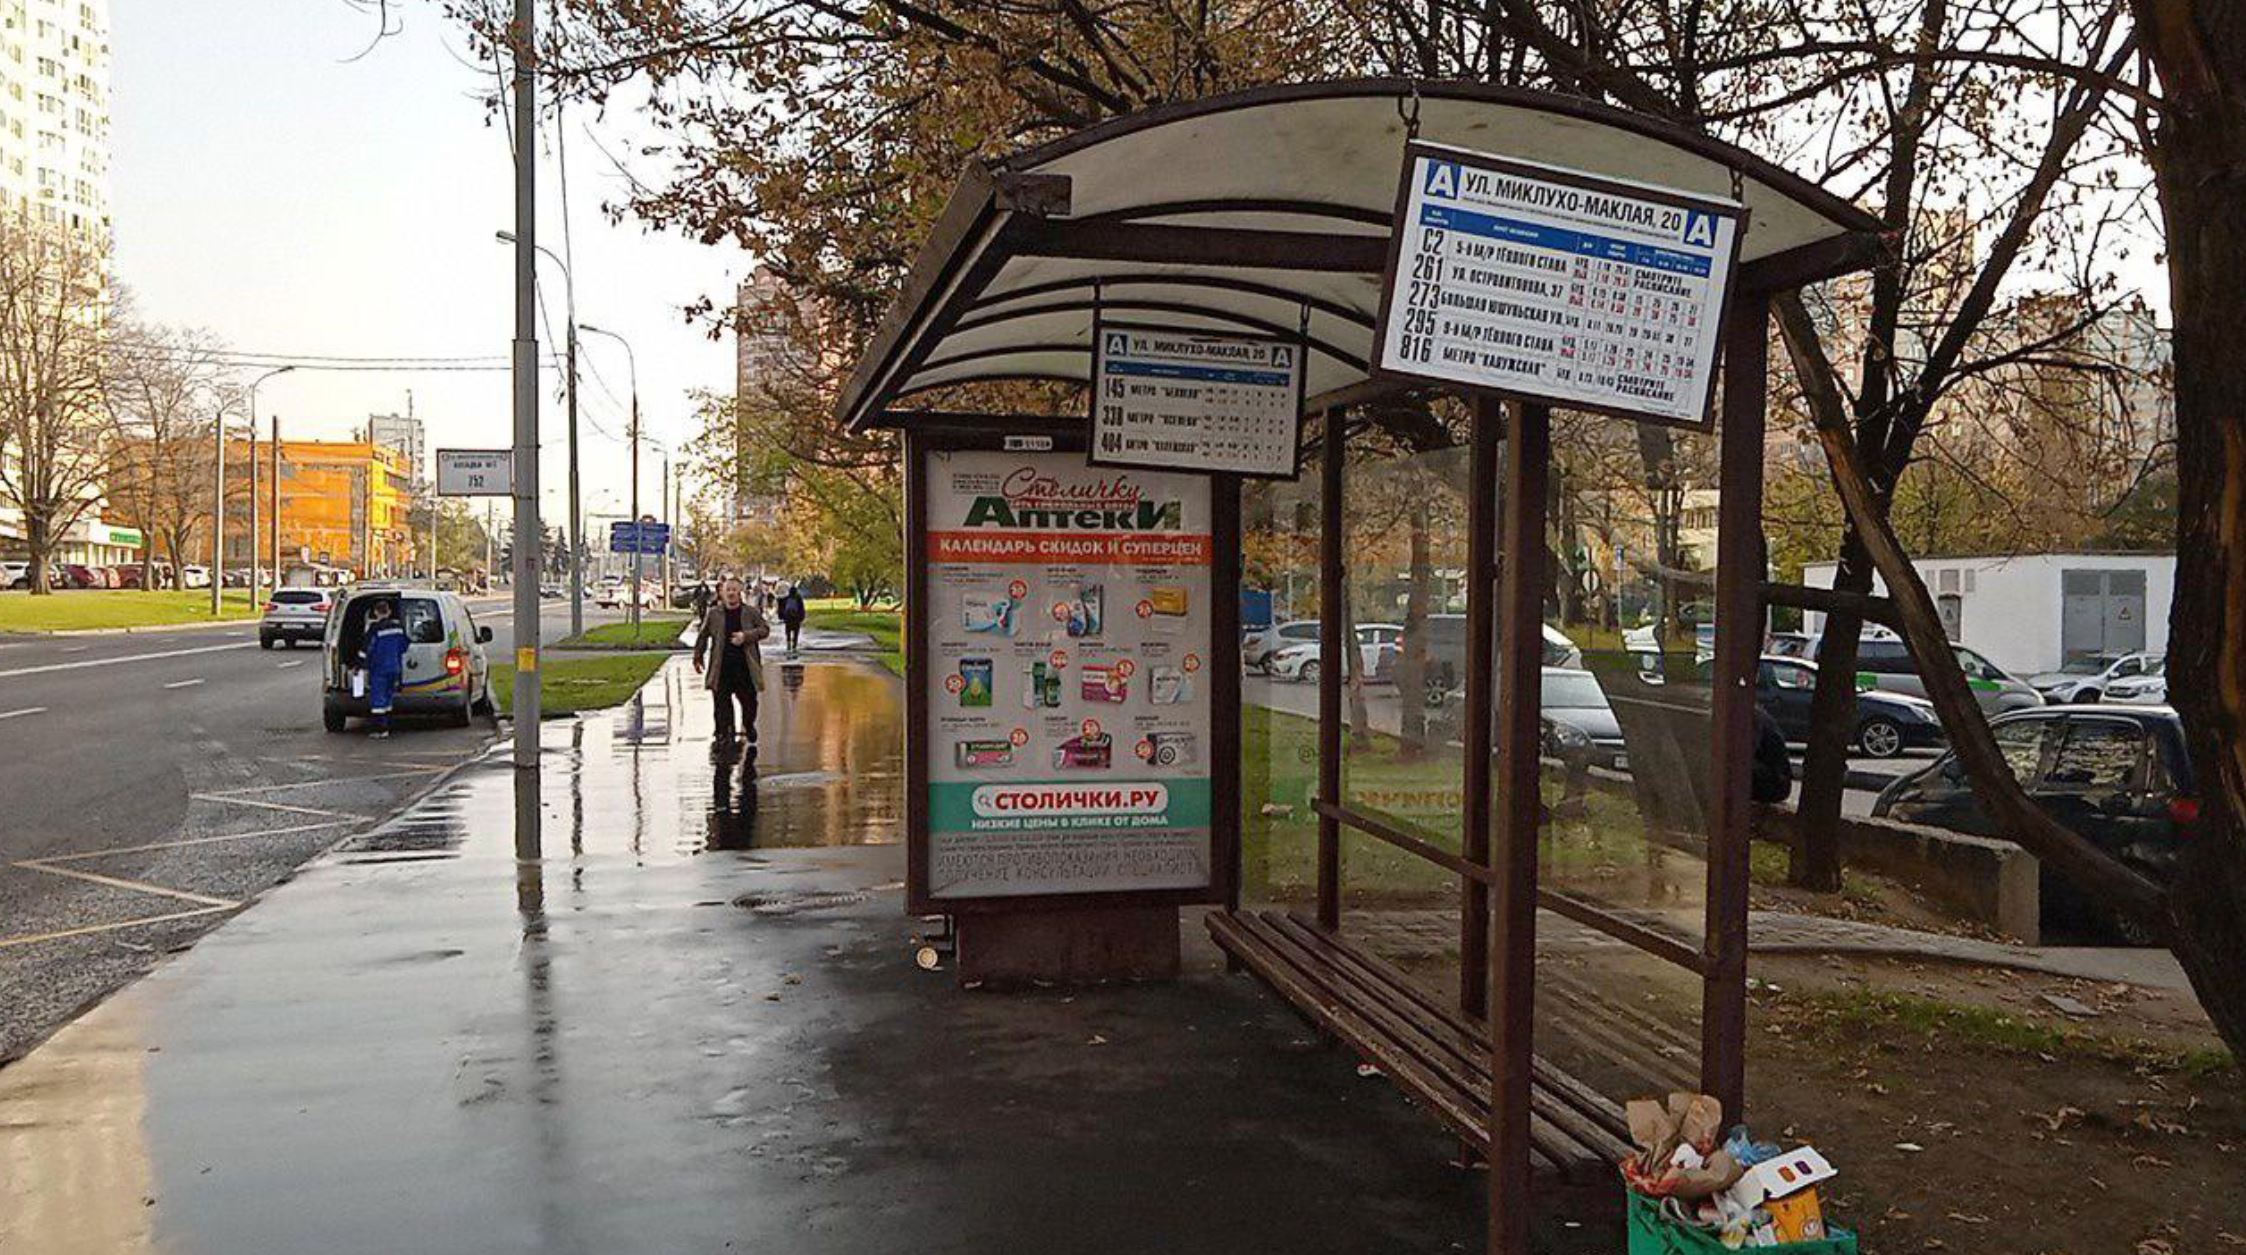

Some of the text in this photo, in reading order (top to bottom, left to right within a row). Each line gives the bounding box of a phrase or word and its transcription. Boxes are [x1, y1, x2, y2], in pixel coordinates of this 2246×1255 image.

[1426, 163, 1457, 198] А
[1466, 172, 1491, 195] УЛ.
[1661, 211, 1682, 231] 20
[1685, 214, 1713, 246] А
[1412, 254, 1444, 283] 261
[1409, 280, 1441, 309] 273
[1403, 308, 1437, 336] 295
[1400, 335, 1433, 363] 816
[1104, 378, 1125, 400] 145
[1101, 432, 1122, 453] 404
[940, 538, 1202, 556] КАЛЕНДАРЬ СКИДОК И СУПЕРЦЕН
[995, 790, 1159, 811] СТОЛИЧКИ.РУ
[1023, 818, 1058, 829] ЦЕНЫ
[1061, 818, 1070, 828] В
[1114, 816, 1129, 827] ОТ
[1132, 815, 1168, 827] ДОМА
